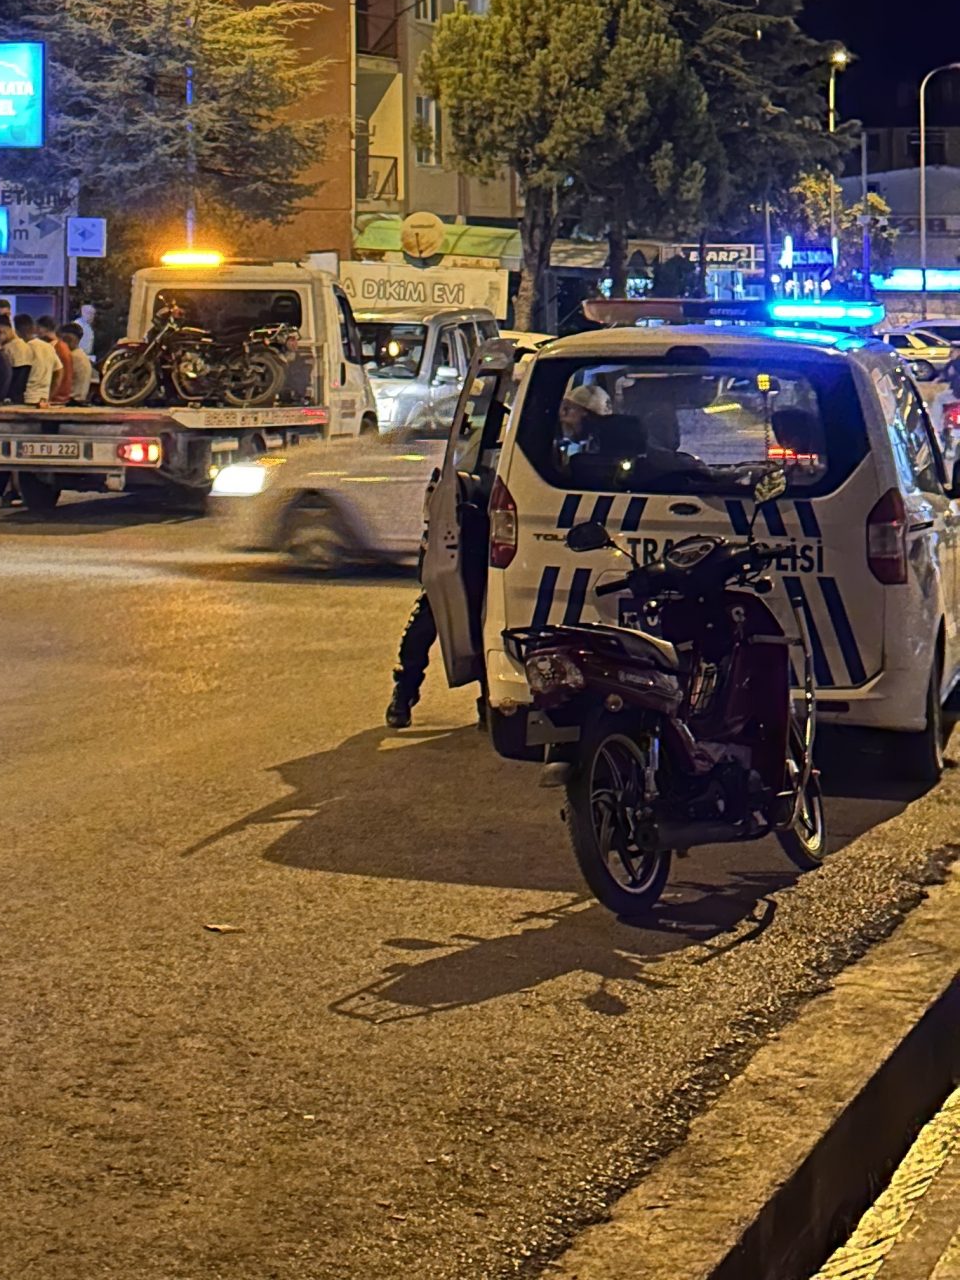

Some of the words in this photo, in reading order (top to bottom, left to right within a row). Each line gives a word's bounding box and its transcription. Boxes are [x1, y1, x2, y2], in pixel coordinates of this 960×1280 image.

[689, 250, 739, 262] EARP
[22, 444, 35, 455] 03
[40, 444, 53, 455] FU
[58, 444, 77, 455] 222
